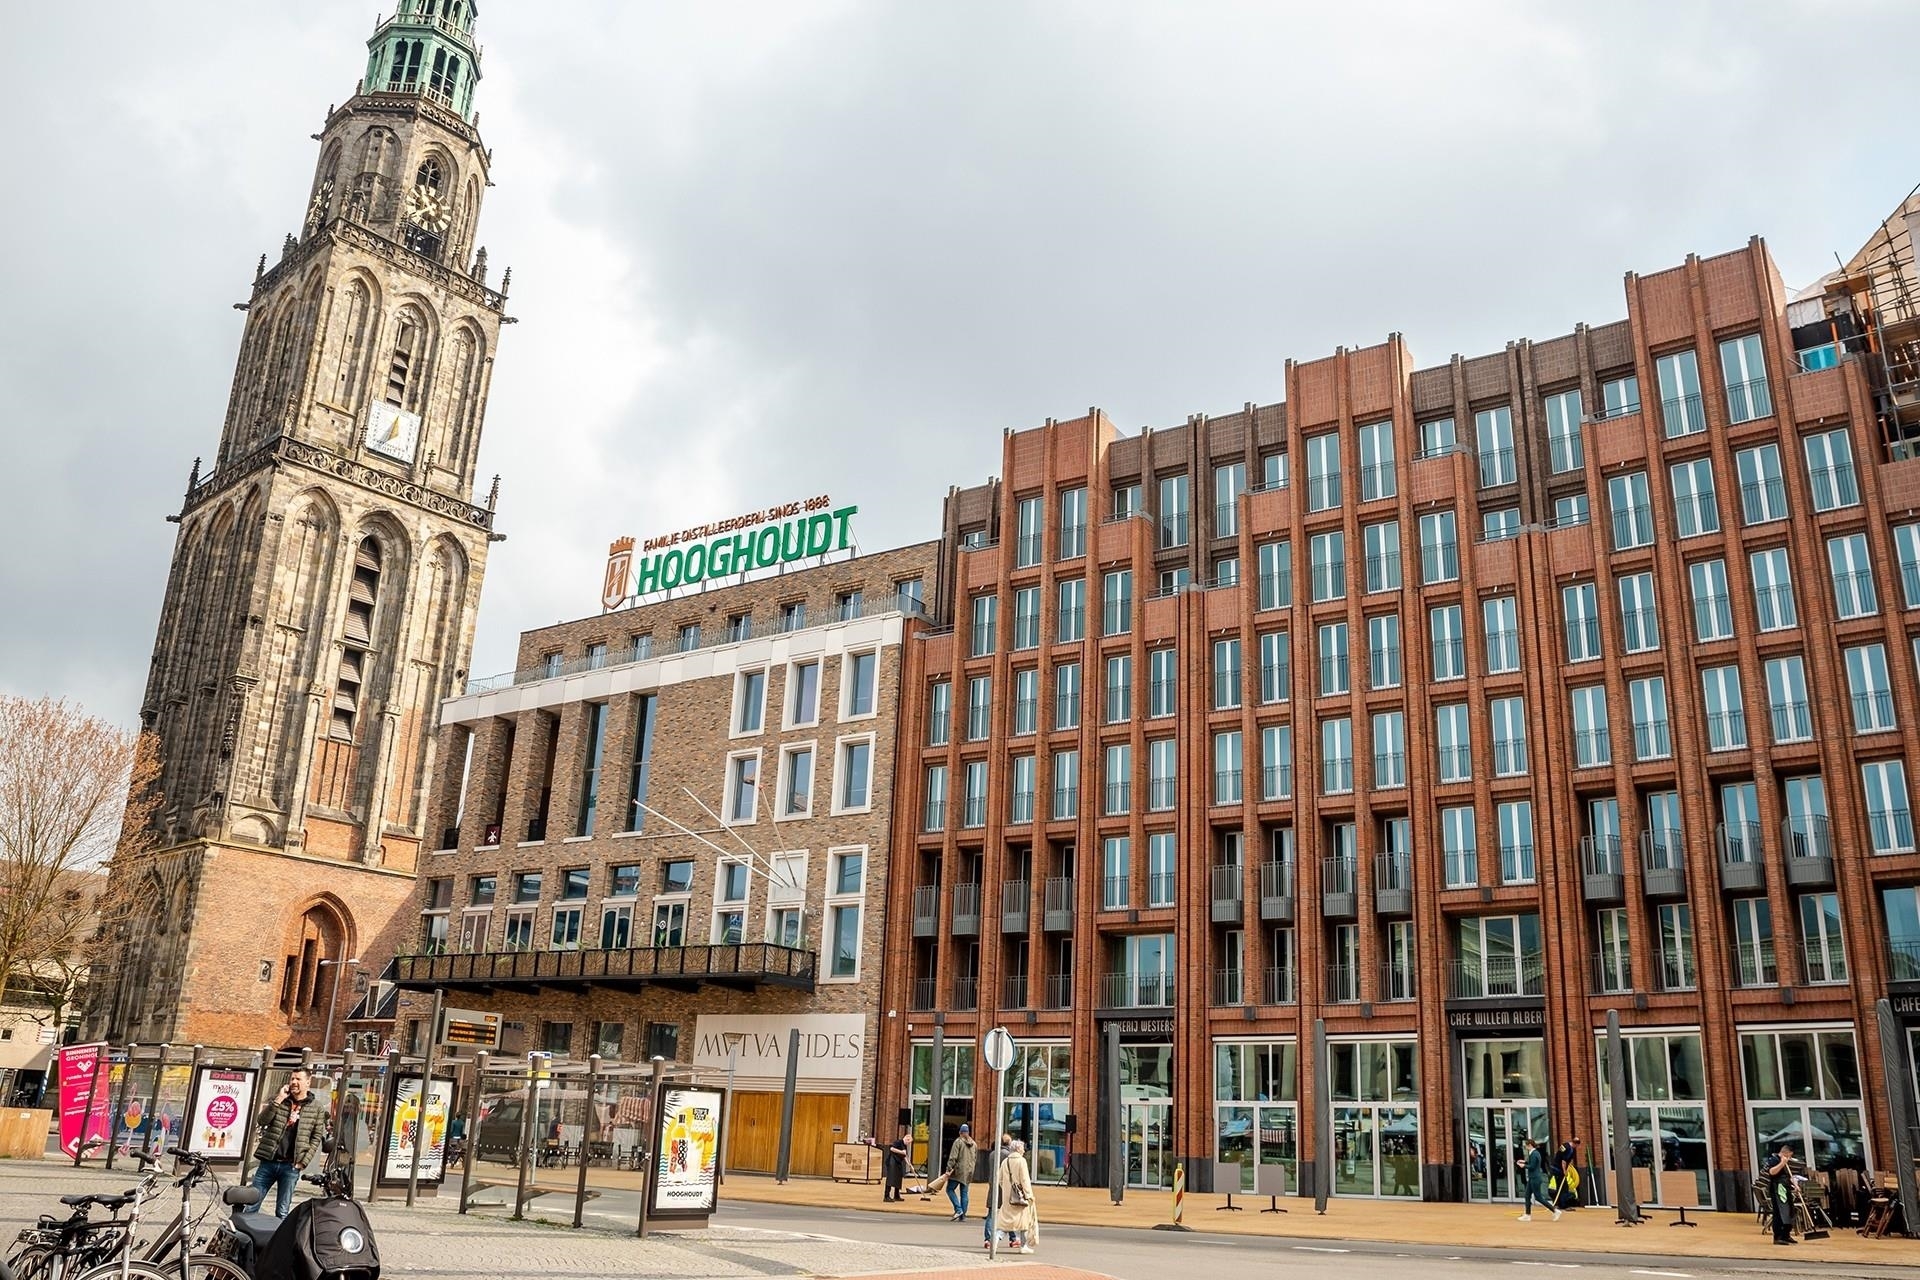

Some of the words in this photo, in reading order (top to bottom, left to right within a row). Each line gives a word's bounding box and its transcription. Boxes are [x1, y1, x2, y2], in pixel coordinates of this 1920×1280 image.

[643, 532, 680, 552] FAMILIE
[767, 501, 800, 521] SINDS
[803, 494, 831, 512] 1888
[637, 505, 858, 595] HOOGHOUDT
[1450, 1012, 1472, 1026] CAFE
[1475, 1011, 1510, 1025] WILLEM
[1103, 1020, 1138, 1032] BKERIJ
[1140, 1020, 1174, 1032] WESTERS
[66, 1047, 98, 1056] BINNENSTA
[66, 1052, 98, 1061] GRONING
[211, 1100, 235, 1112] 25%
